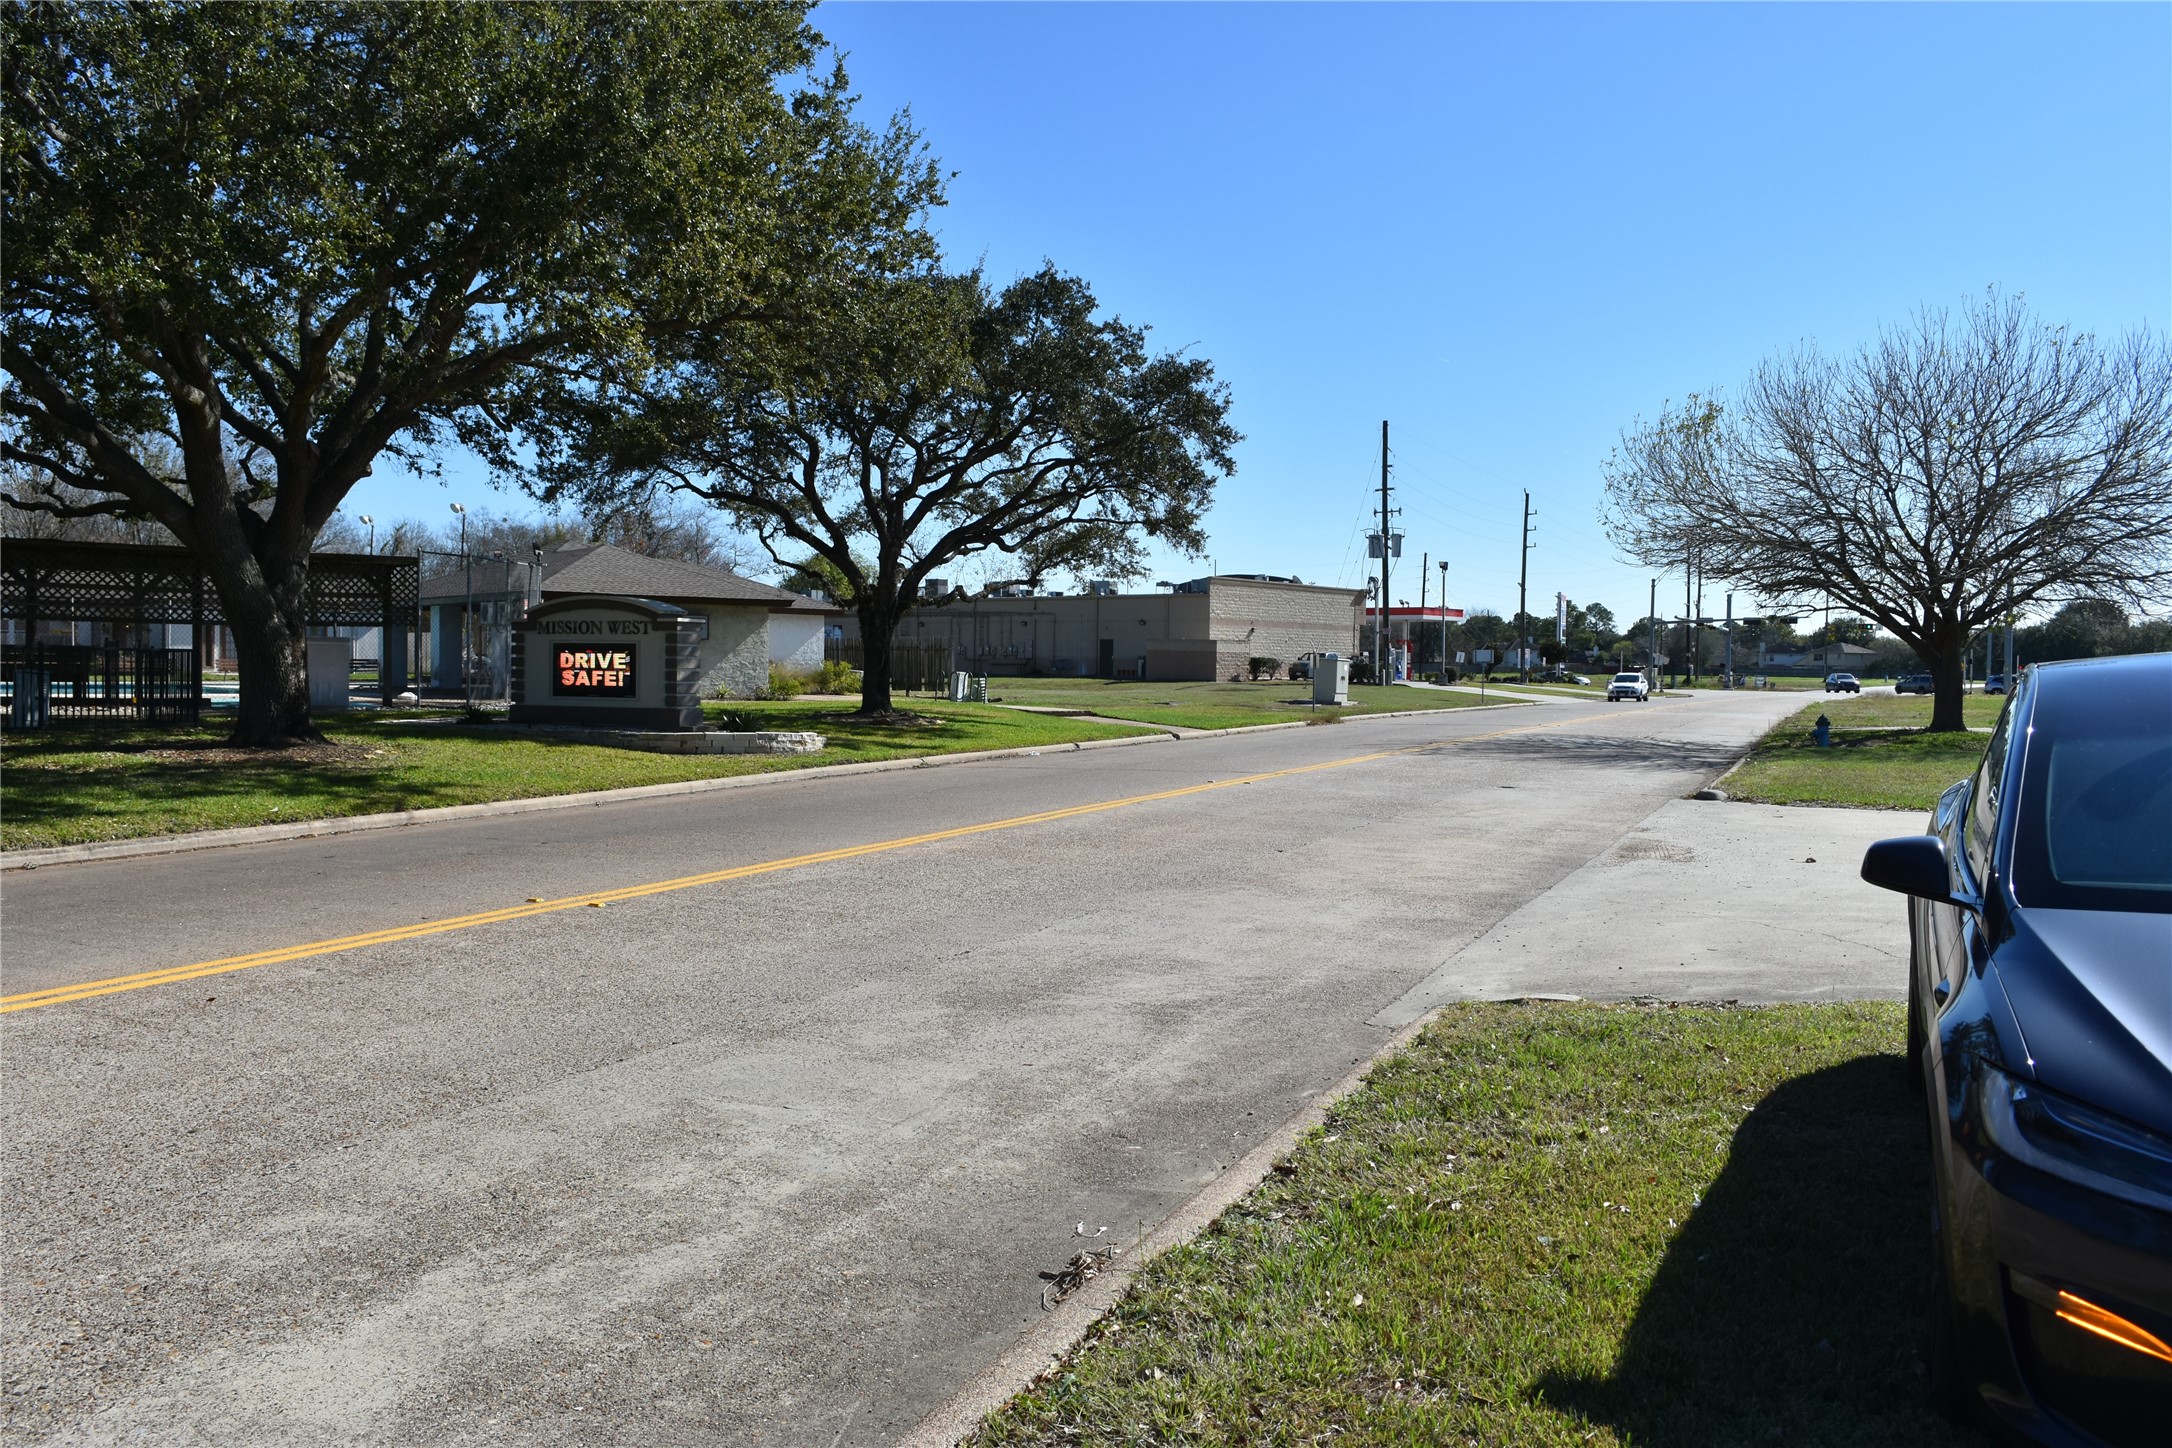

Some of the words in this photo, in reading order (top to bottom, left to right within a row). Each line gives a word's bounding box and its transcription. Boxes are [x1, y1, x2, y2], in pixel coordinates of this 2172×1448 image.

[537, 620, 603, 635] MISSION
[607, 620, 652, 635] WEST
[559, 652, 627, 669] DRIVE
[561, 670, 624, 687] SAFE!
